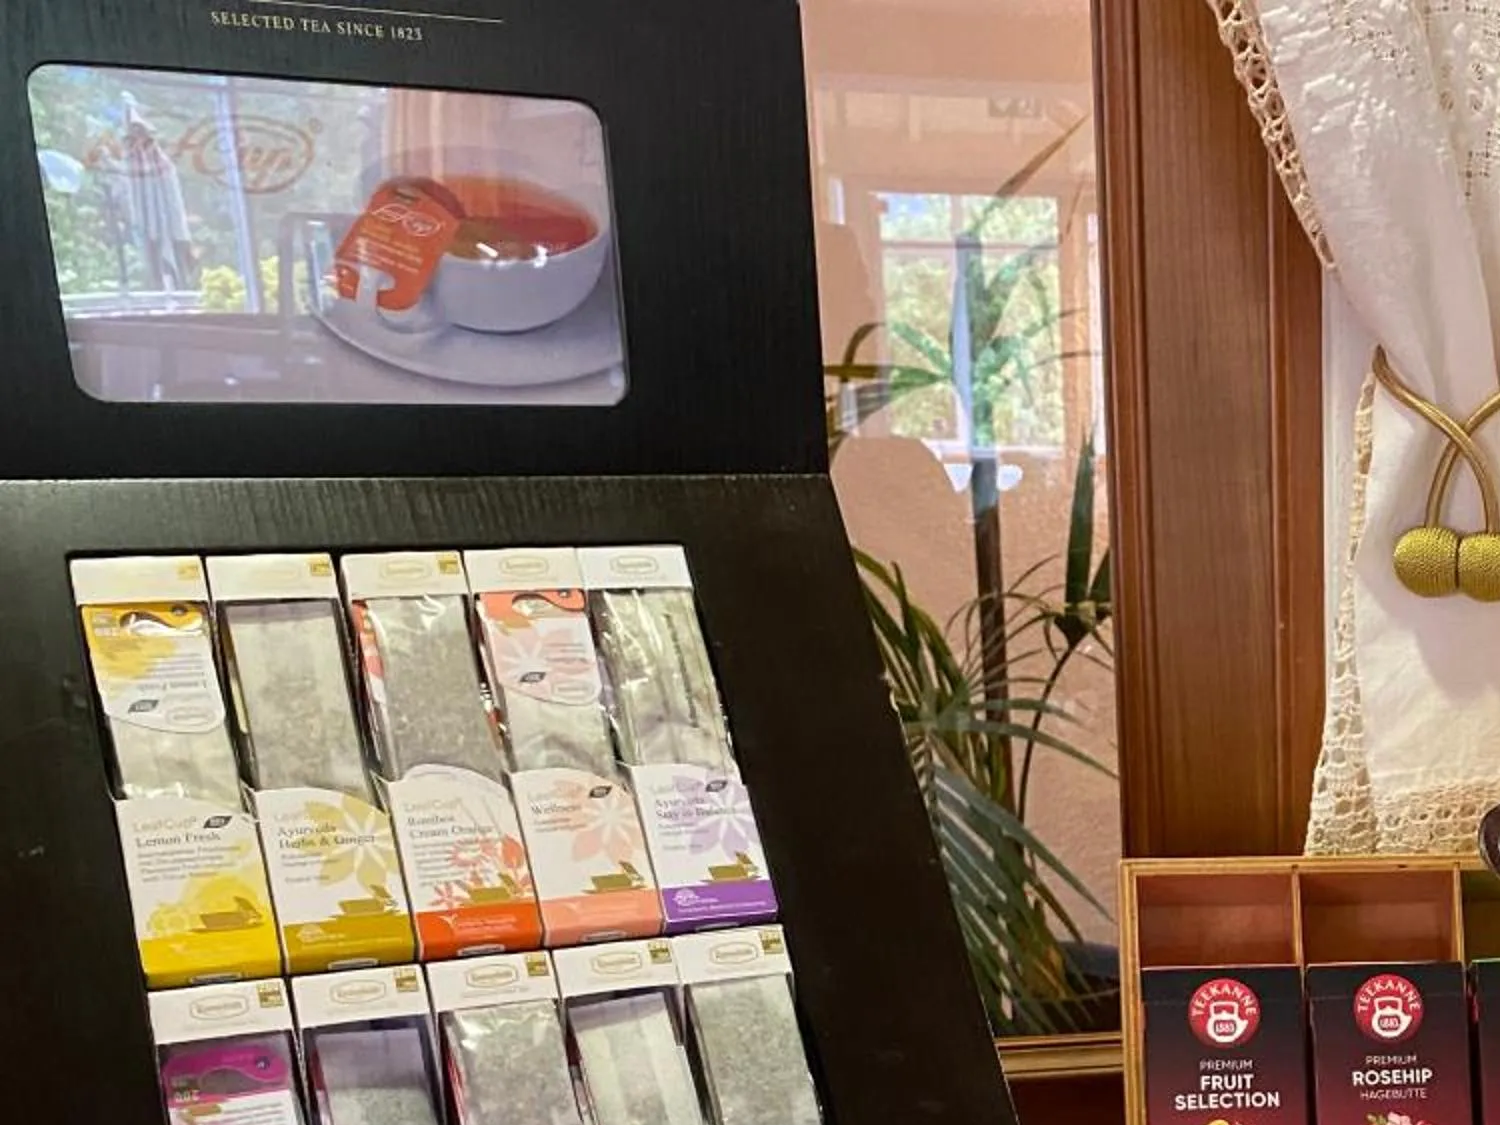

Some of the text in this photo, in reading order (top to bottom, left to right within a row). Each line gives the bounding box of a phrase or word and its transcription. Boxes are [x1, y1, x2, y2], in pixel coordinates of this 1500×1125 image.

[211, 11, 423, 41] SELECTED TEA SINCE 1823
[136, 831, 221, 849] Lemon Fresh
[1191, 981, 1258, 1018] TEEKANNE
[1357, 978, 1421, 1013] TEEKANNE
[1200, 1058, 1254, 1070] PREMIUM
[1365, 1054, 1418, 1066] PREMIUM
[1200, 1073, 1254, 1092] FRUIT
[1352, 1068, 1434, 1086] ROSEHIP
[1175, 1091, 1281, 1112] SELECTION
[1361, 1086, 1428, 1100] HAGEBUTTE
